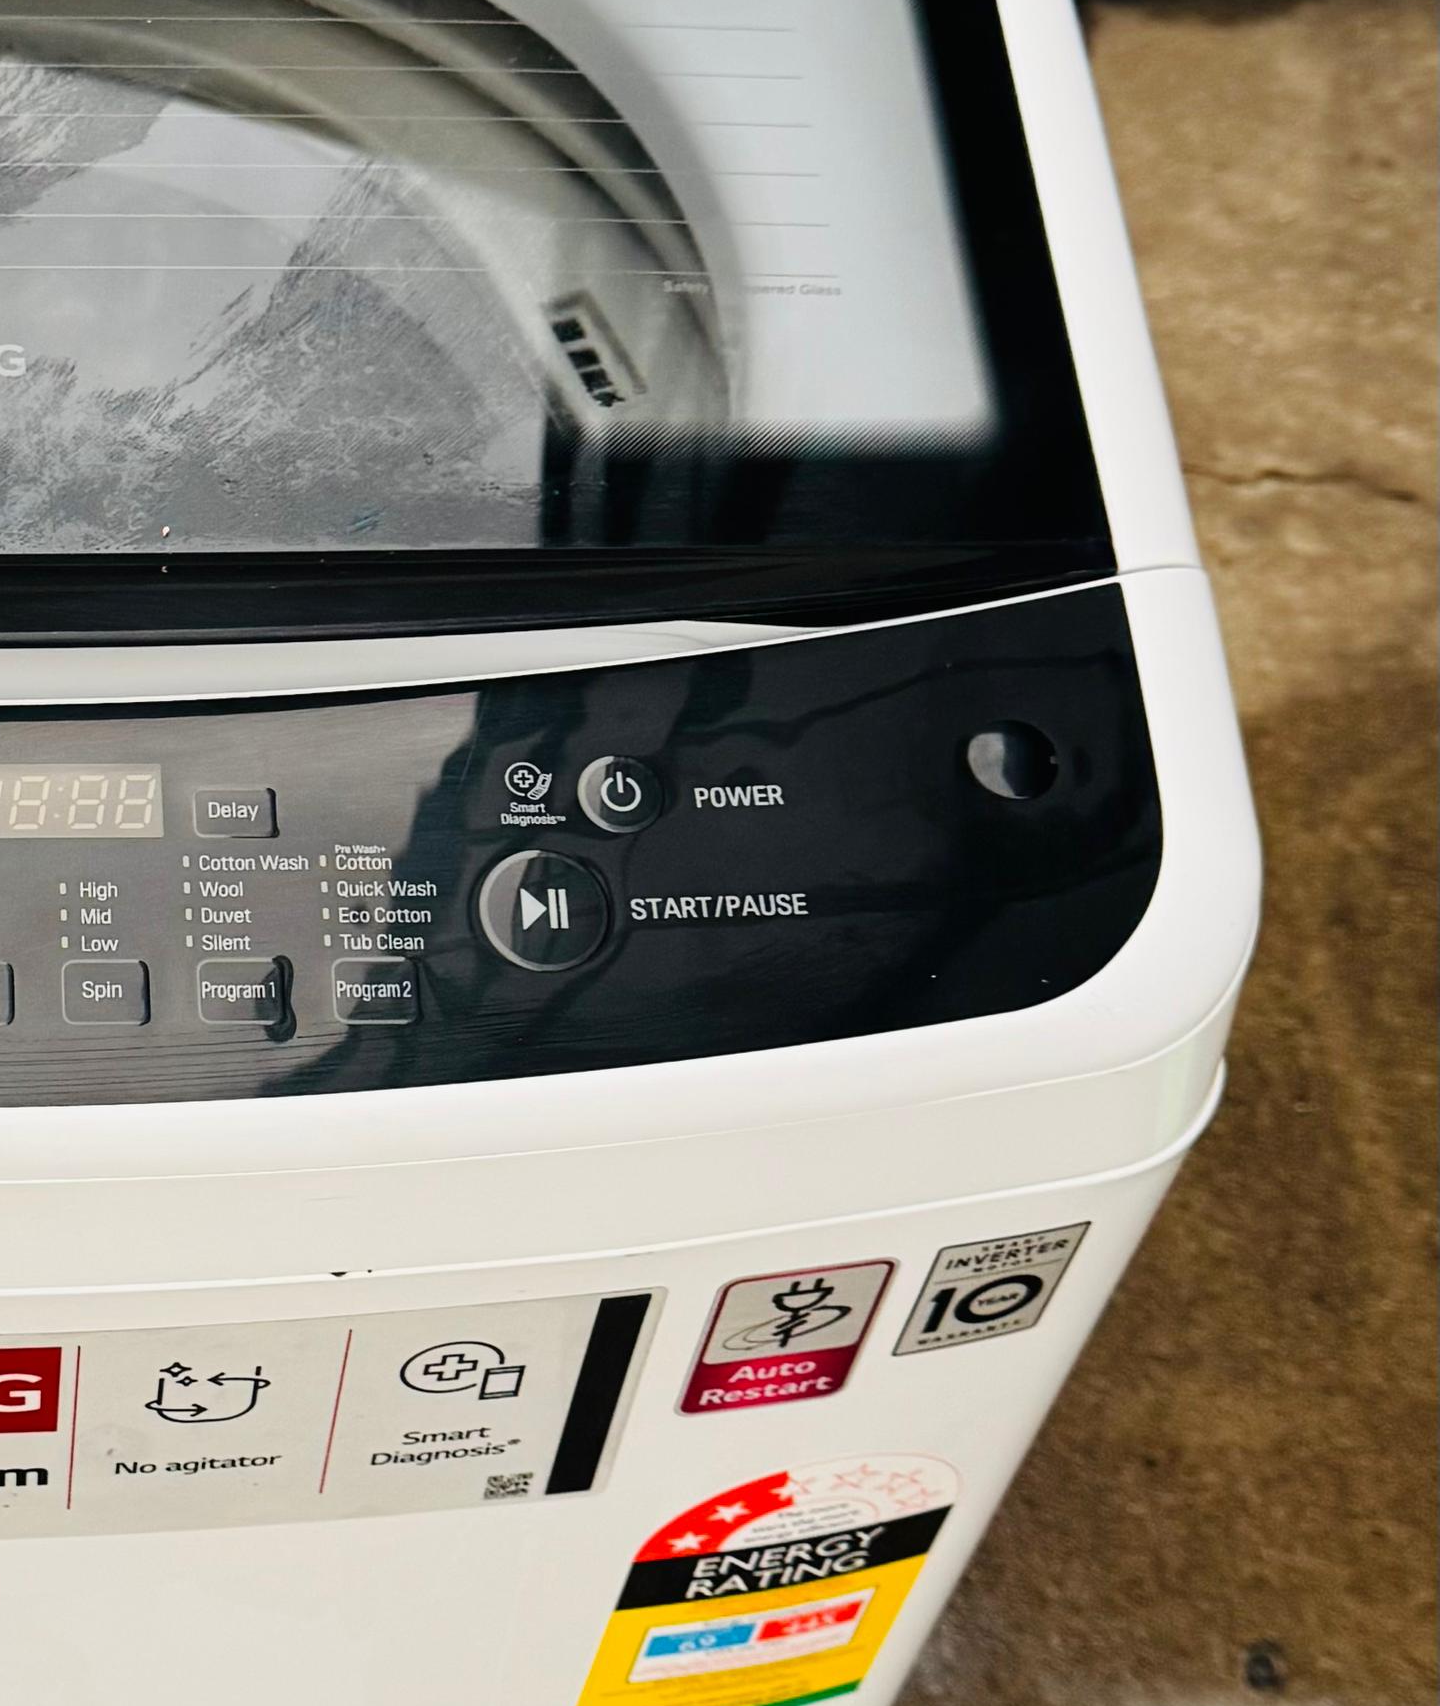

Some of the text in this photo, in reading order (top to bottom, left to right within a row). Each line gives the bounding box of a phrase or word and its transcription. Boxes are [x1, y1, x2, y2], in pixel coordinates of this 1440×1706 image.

[694, 785, 784, 808] POWER
[208, 802, 258, 821] Delay
[510, 802, 545, 813] Smart
[335, 845, 351, 853] Pre
[199, 855, 309, 870] Cotton Wash
[336, 855, 392, 870] Cotton
[80, 882, 118, 901] High
[199, 881, 243, 897] Wool
[337, 881, 437, 897] Quick Wash
[81, 909, 111, 924] Mid
[201, 908, 251, 923] Duvet
[339, 908, 431, 923] Eco Cotton
[631, 893, 808, 921] START/PAUSE
[82, 936, 119, 952] Low
[201, 935, 251, 951] Silent
[340, 935, 424, 950] Tub Clean
[82, 981, 122, 1002] Spin
[202, 982, 265, 1001] Program
[946, 1239, 1069, 1269] INVERTER
[922, 1274, 1043, 1333] 10
[728, 1360, 817, 1384] Auto
[698, 1375, 833, 1406] Restart
[402, 1426, 491, 1446] Smart
[115, 1453, 282, 1475] No agitator
[693, 1526, 886, 1579] ENERGY
[685, 1550, 870, 1600] RATING
